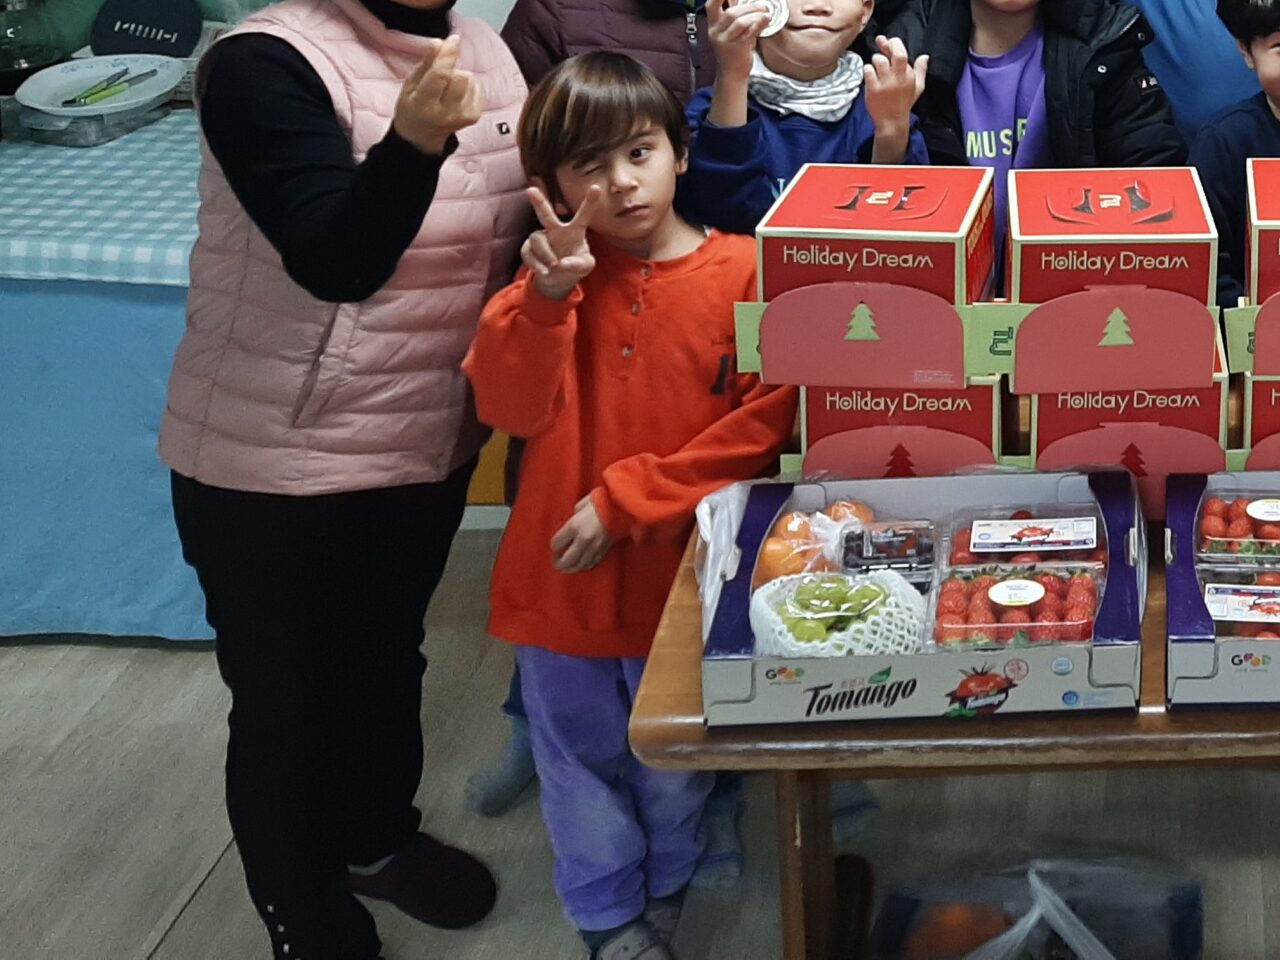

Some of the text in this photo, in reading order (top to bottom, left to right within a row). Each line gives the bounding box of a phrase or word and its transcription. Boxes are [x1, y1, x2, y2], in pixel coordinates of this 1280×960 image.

[783, 244, 934, 272] Holiday Dream
[1041, 250, 1190, 275] Holiday Dream
[826, 391, 973, 415] Holiday Dream
[1058, 390, 1201, 414] Holiday Dream
[803, 678, 917, 717] Tomango
